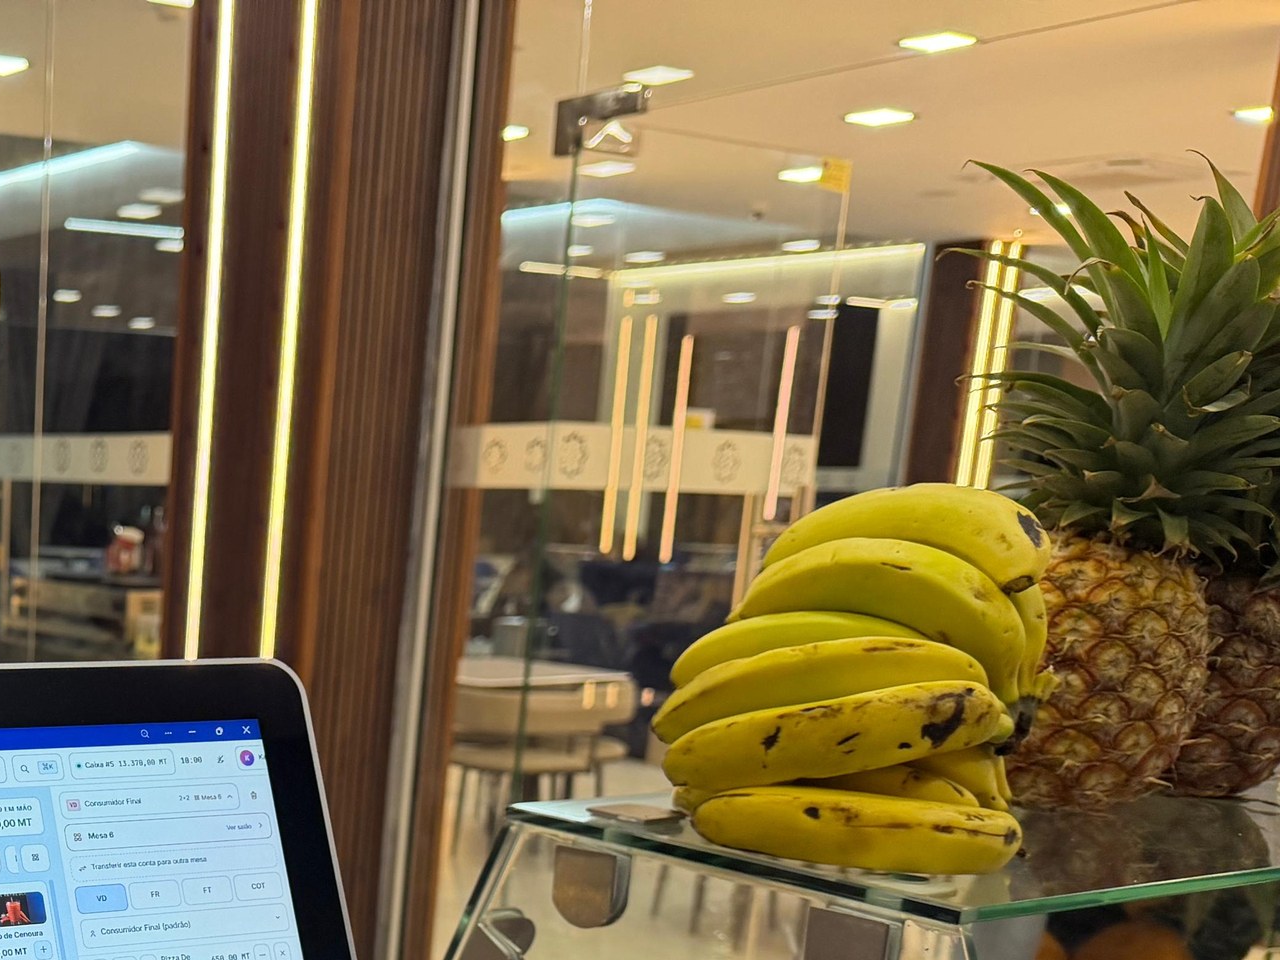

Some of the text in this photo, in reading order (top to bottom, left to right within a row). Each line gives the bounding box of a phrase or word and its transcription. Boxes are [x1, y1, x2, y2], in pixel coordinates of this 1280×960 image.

[17, 818, 32, 826] MT
[101, 921, 191, 935] Consumidor Final (padrão)
[242, 952, 250, 960] MT
